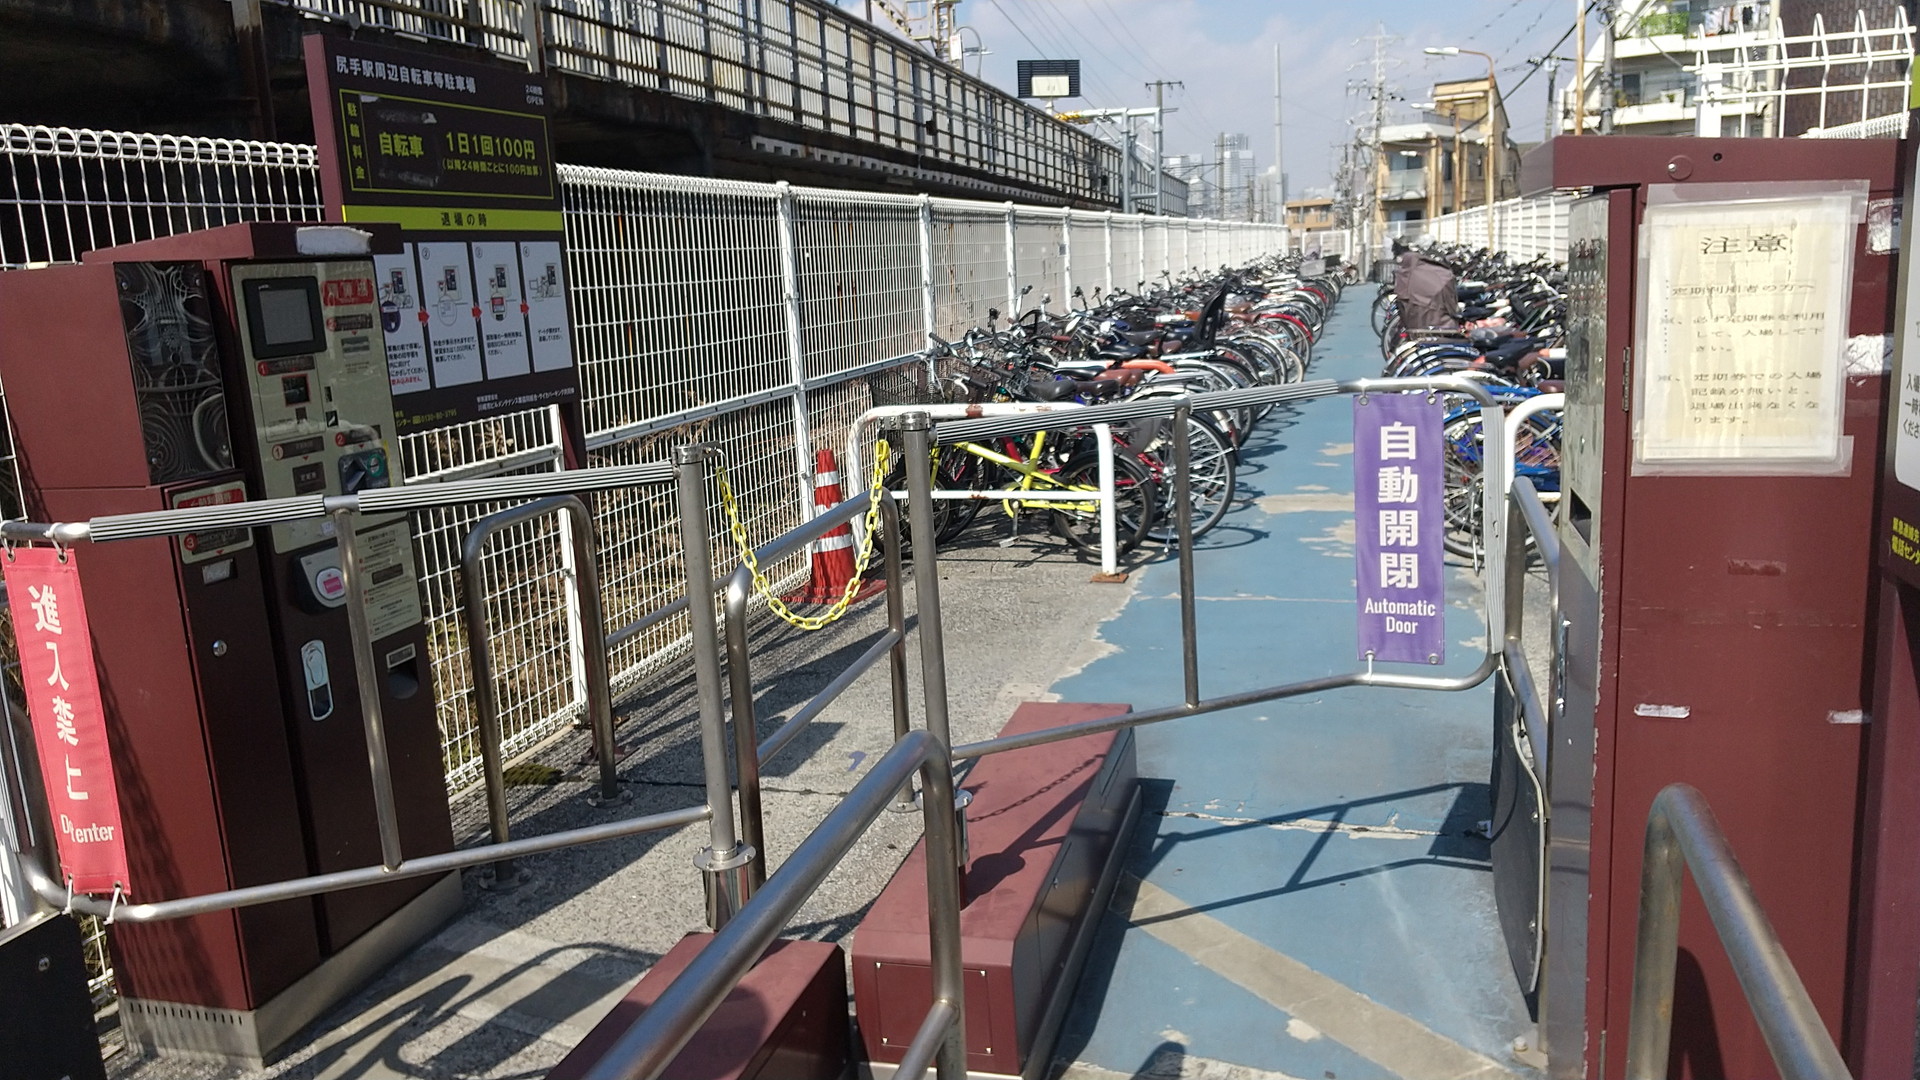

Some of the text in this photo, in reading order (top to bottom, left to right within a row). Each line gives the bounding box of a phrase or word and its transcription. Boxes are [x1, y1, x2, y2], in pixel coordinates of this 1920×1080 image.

[335, 55, 476, 94] 尻手駅周辺自転車等駐車場
[379, 131, 424, 159] 自転車
[445, 131, 536, 161] 1日1回100円
[441, 212, 488, 227] 退場の時
[1699, 233, 1790, 255] 注意
[1377, 421, 1419, 590] 自動開閉
[1364, 597, 1436, 618] Automatic
[1385, 616, 1418, 634] Door
